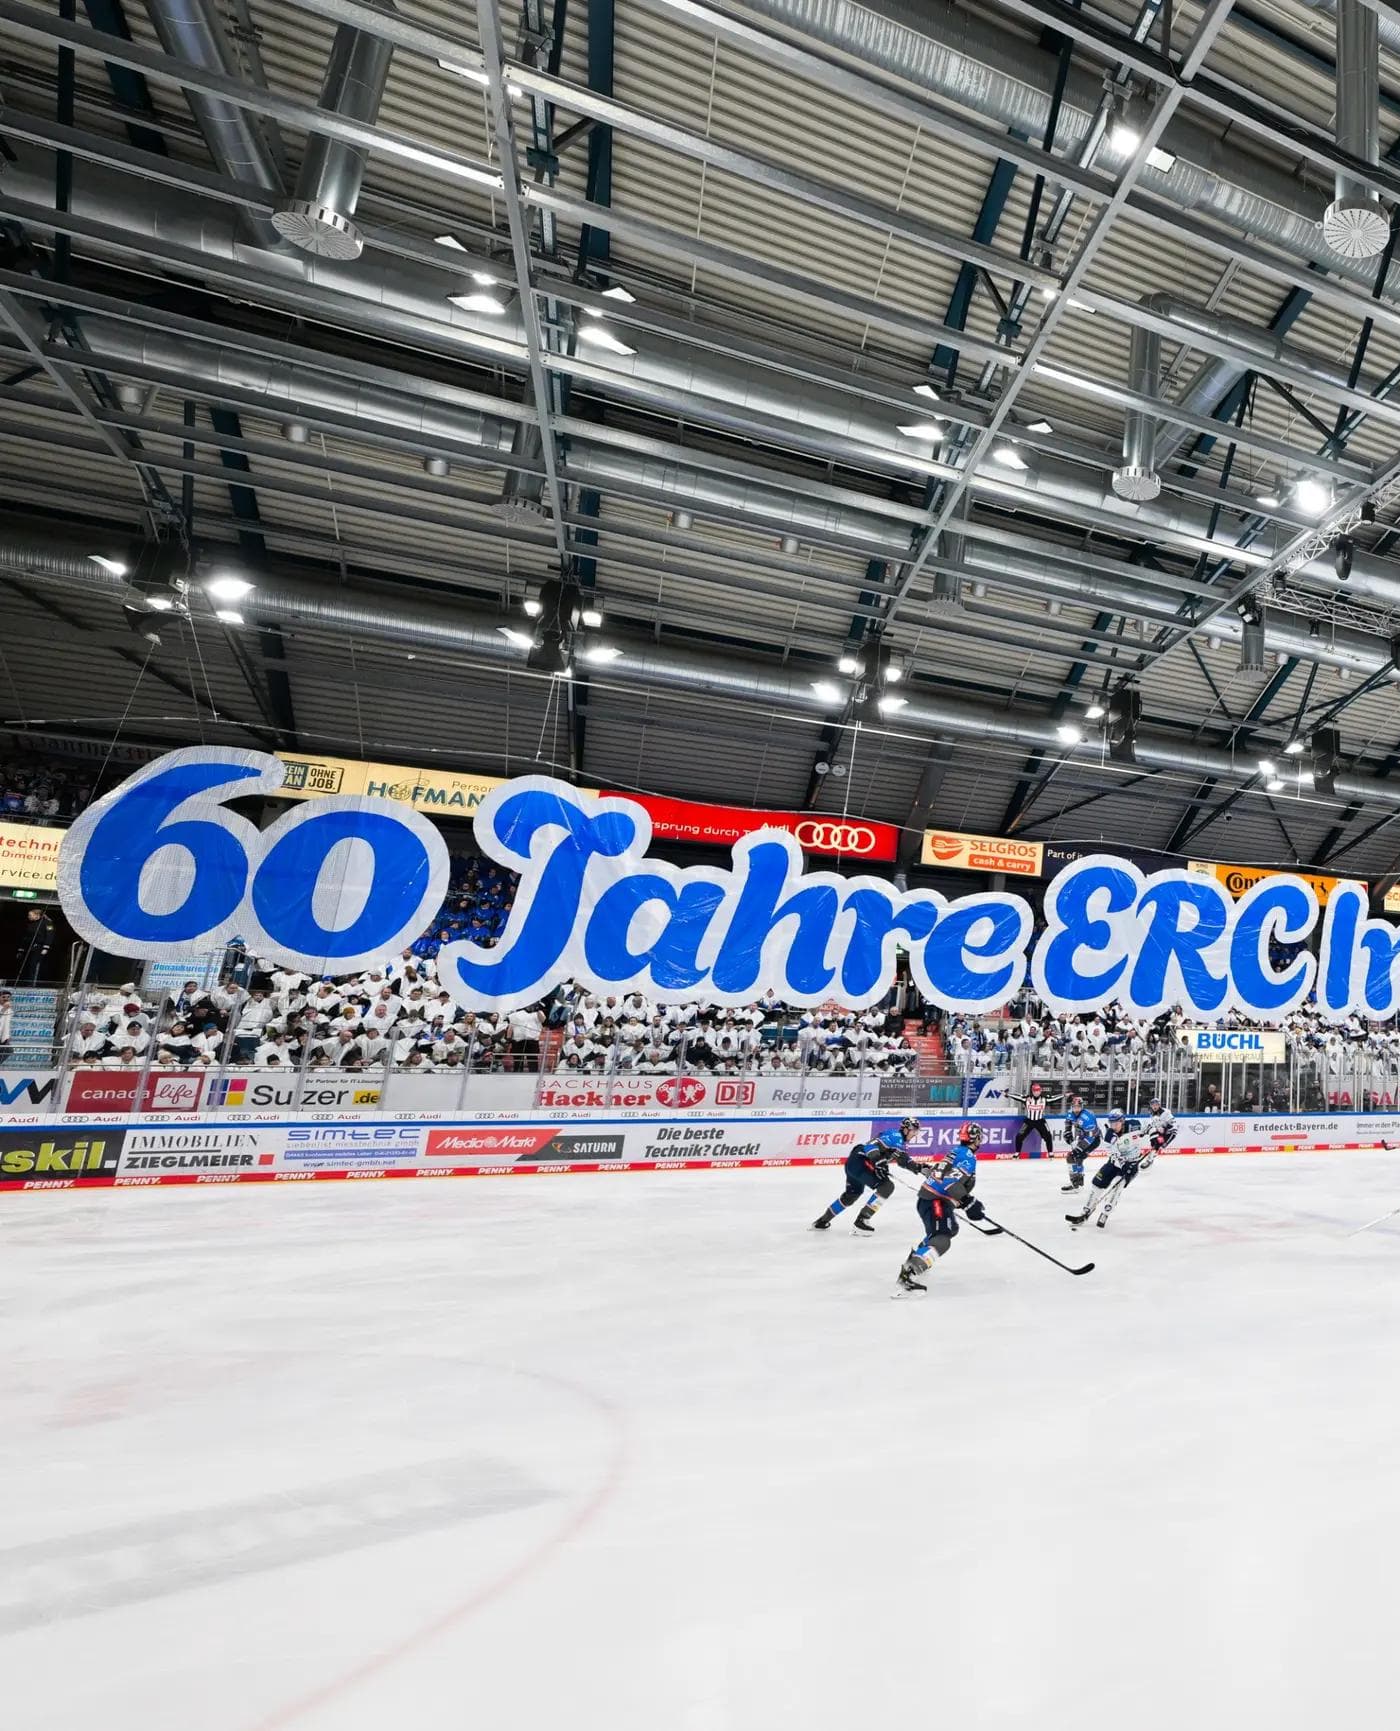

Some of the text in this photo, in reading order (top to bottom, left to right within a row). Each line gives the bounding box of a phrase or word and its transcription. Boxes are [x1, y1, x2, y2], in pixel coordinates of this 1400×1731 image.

[310, 769, 336, 780] OHNE
[308, 777, 336, 790] JOB.
[704, 826, 739, 837] durch
[969, 839, 1037, 857] SELGROS
[1047, 849, 1064, 860] Part
[1066, 851, 1077, 860] of
[80, 762, 431, 958] 60
[973, 857, 995, 866] cash
[1006, 860, 1032, 872] carry
[457, 790, 1022, 1000] Jahre
[1045, 866, 1310, 1010] ERC
[1197, 1033, 1264, 1050] BÜCHL
[81, 1083, 195, 1105] canada life
[539, 1090, 652, 1107] Hackner
[721, 1084, 750, 1101] DB
[772, 1089, 815, 1104] Regio
[820, 1089, 873, 1104] Bayern
[8, 1116, 39, 1124] Audi
[93, 1115, 122, 1123] Audi
[174, 1114, 201, 1122] Audi
[287, 1128, 421, 1141] simtec
[657, 1127, 724, 1140] Die beste
[796, 1133, 855, 1146] LET'S GO!
[131, 1134, 260, 1150] IMMOBILIEN
[573, 1142, 616, 1154] SATURN
[645, 1143, 760, 1158] Technik? Check!
[124, 1153, 254, 1170] ZIEGLMEIER
